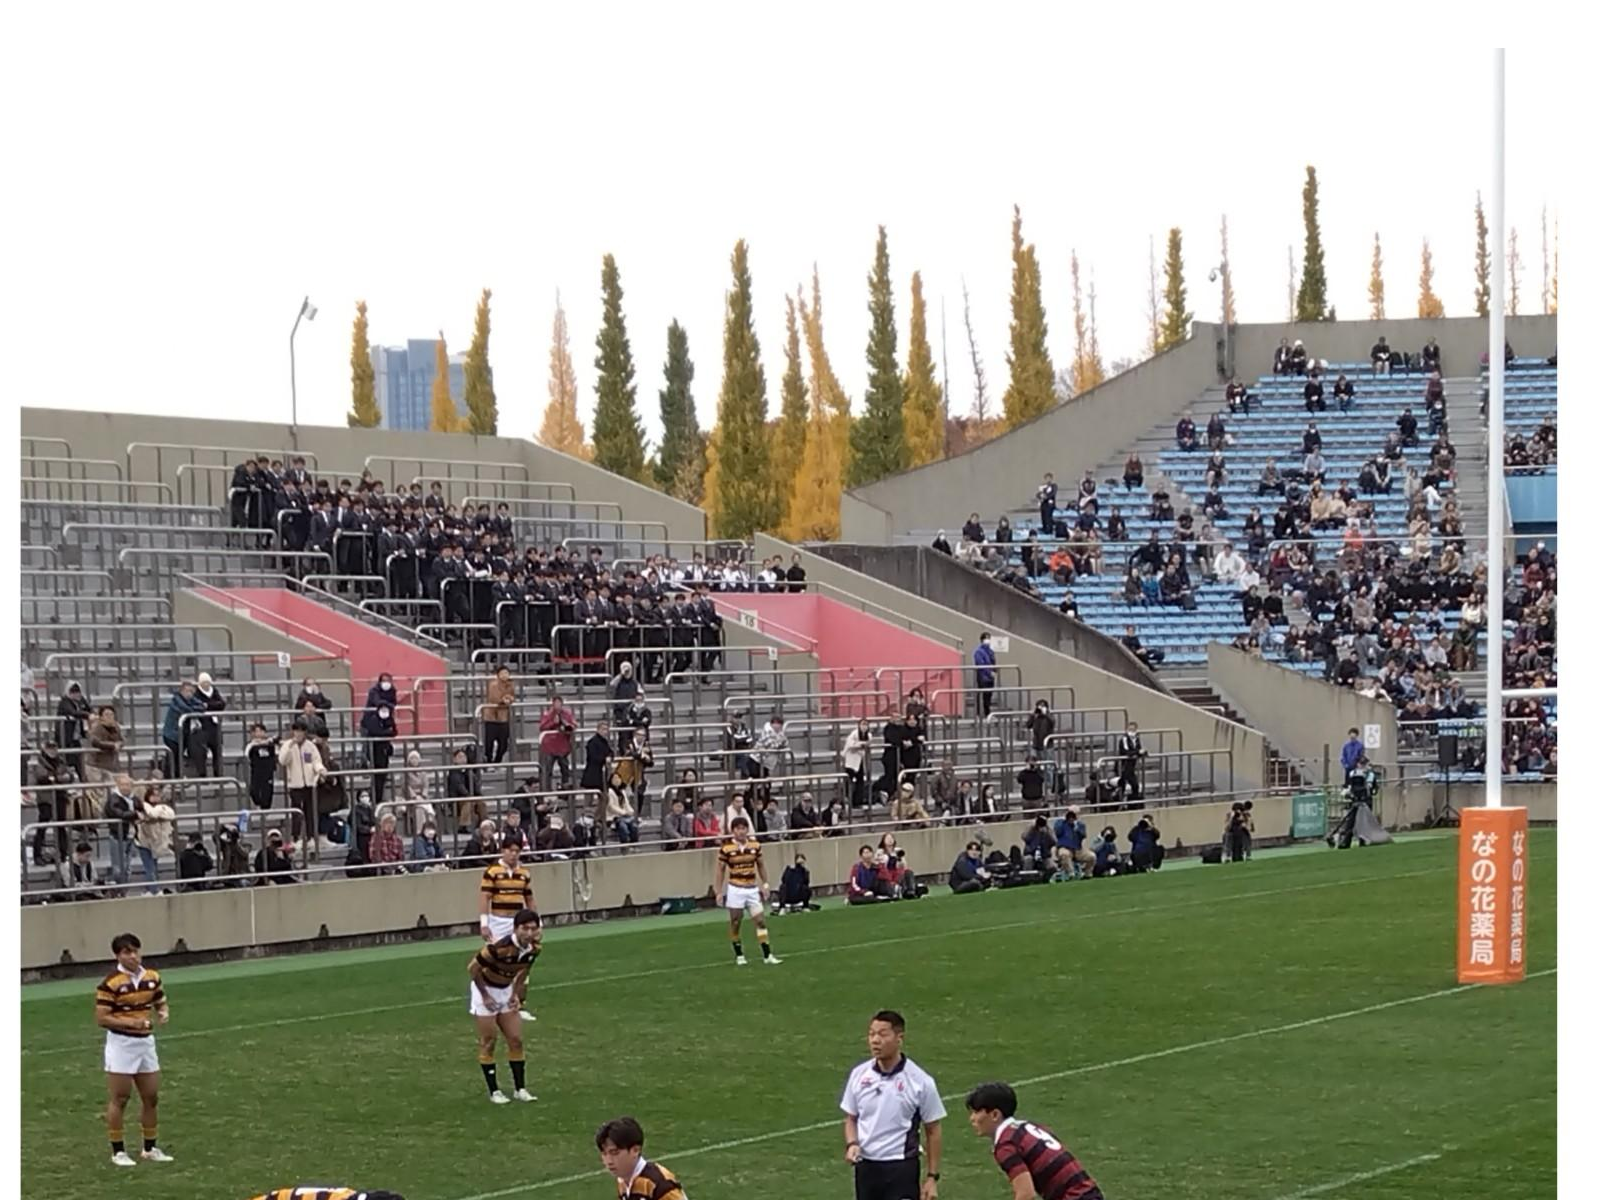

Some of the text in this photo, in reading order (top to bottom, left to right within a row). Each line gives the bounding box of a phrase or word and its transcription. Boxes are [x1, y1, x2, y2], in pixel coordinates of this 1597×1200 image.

[1469, 830, 1499, 966] なの花薬局
[1510, 830, 1525, 965] なの花薬局
[1024, 1123, 1062, 1150] 9
